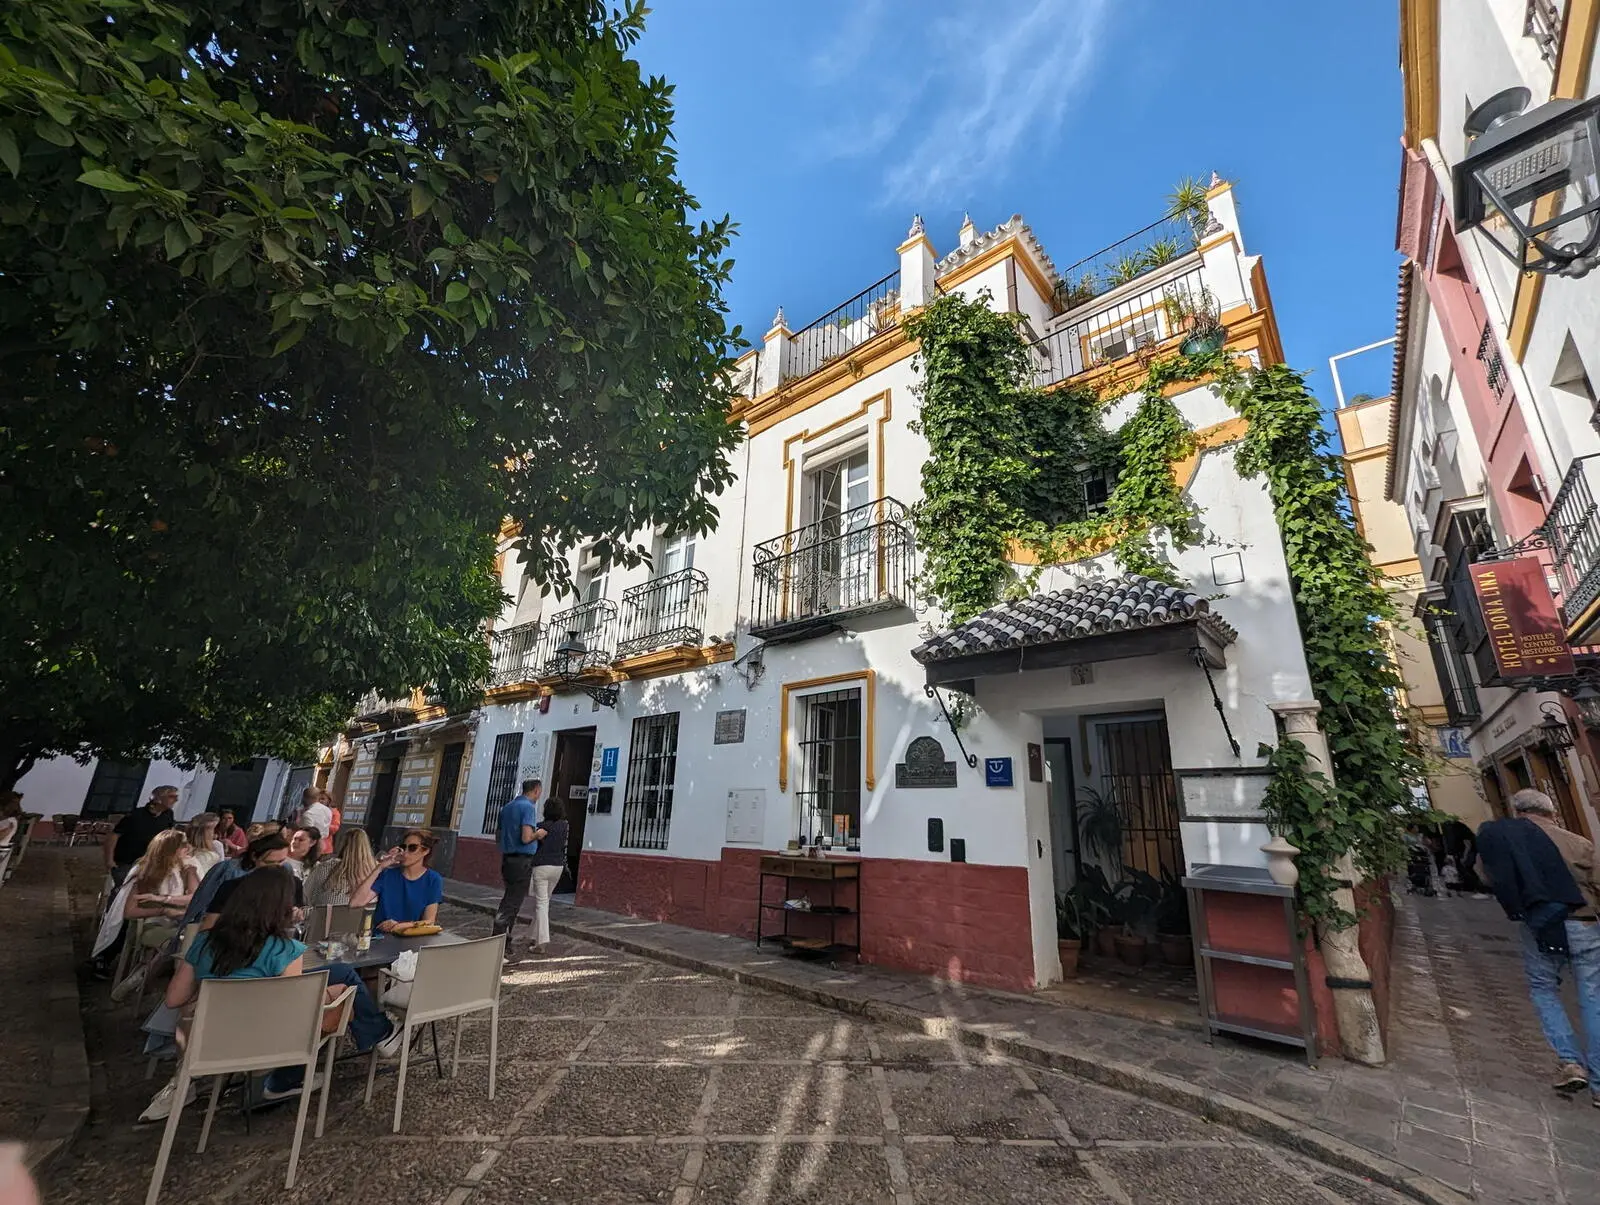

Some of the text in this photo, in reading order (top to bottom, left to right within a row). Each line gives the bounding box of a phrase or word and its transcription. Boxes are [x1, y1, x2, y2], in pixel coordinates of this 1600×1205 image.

[1478, 571, 1523, 669] HOTEL DOÑA LINA
[1520, 633, 1556, 642] HOTELES
[1523, 640, 1556, 648] CENTRO
[606, 751, 615, 767] H
